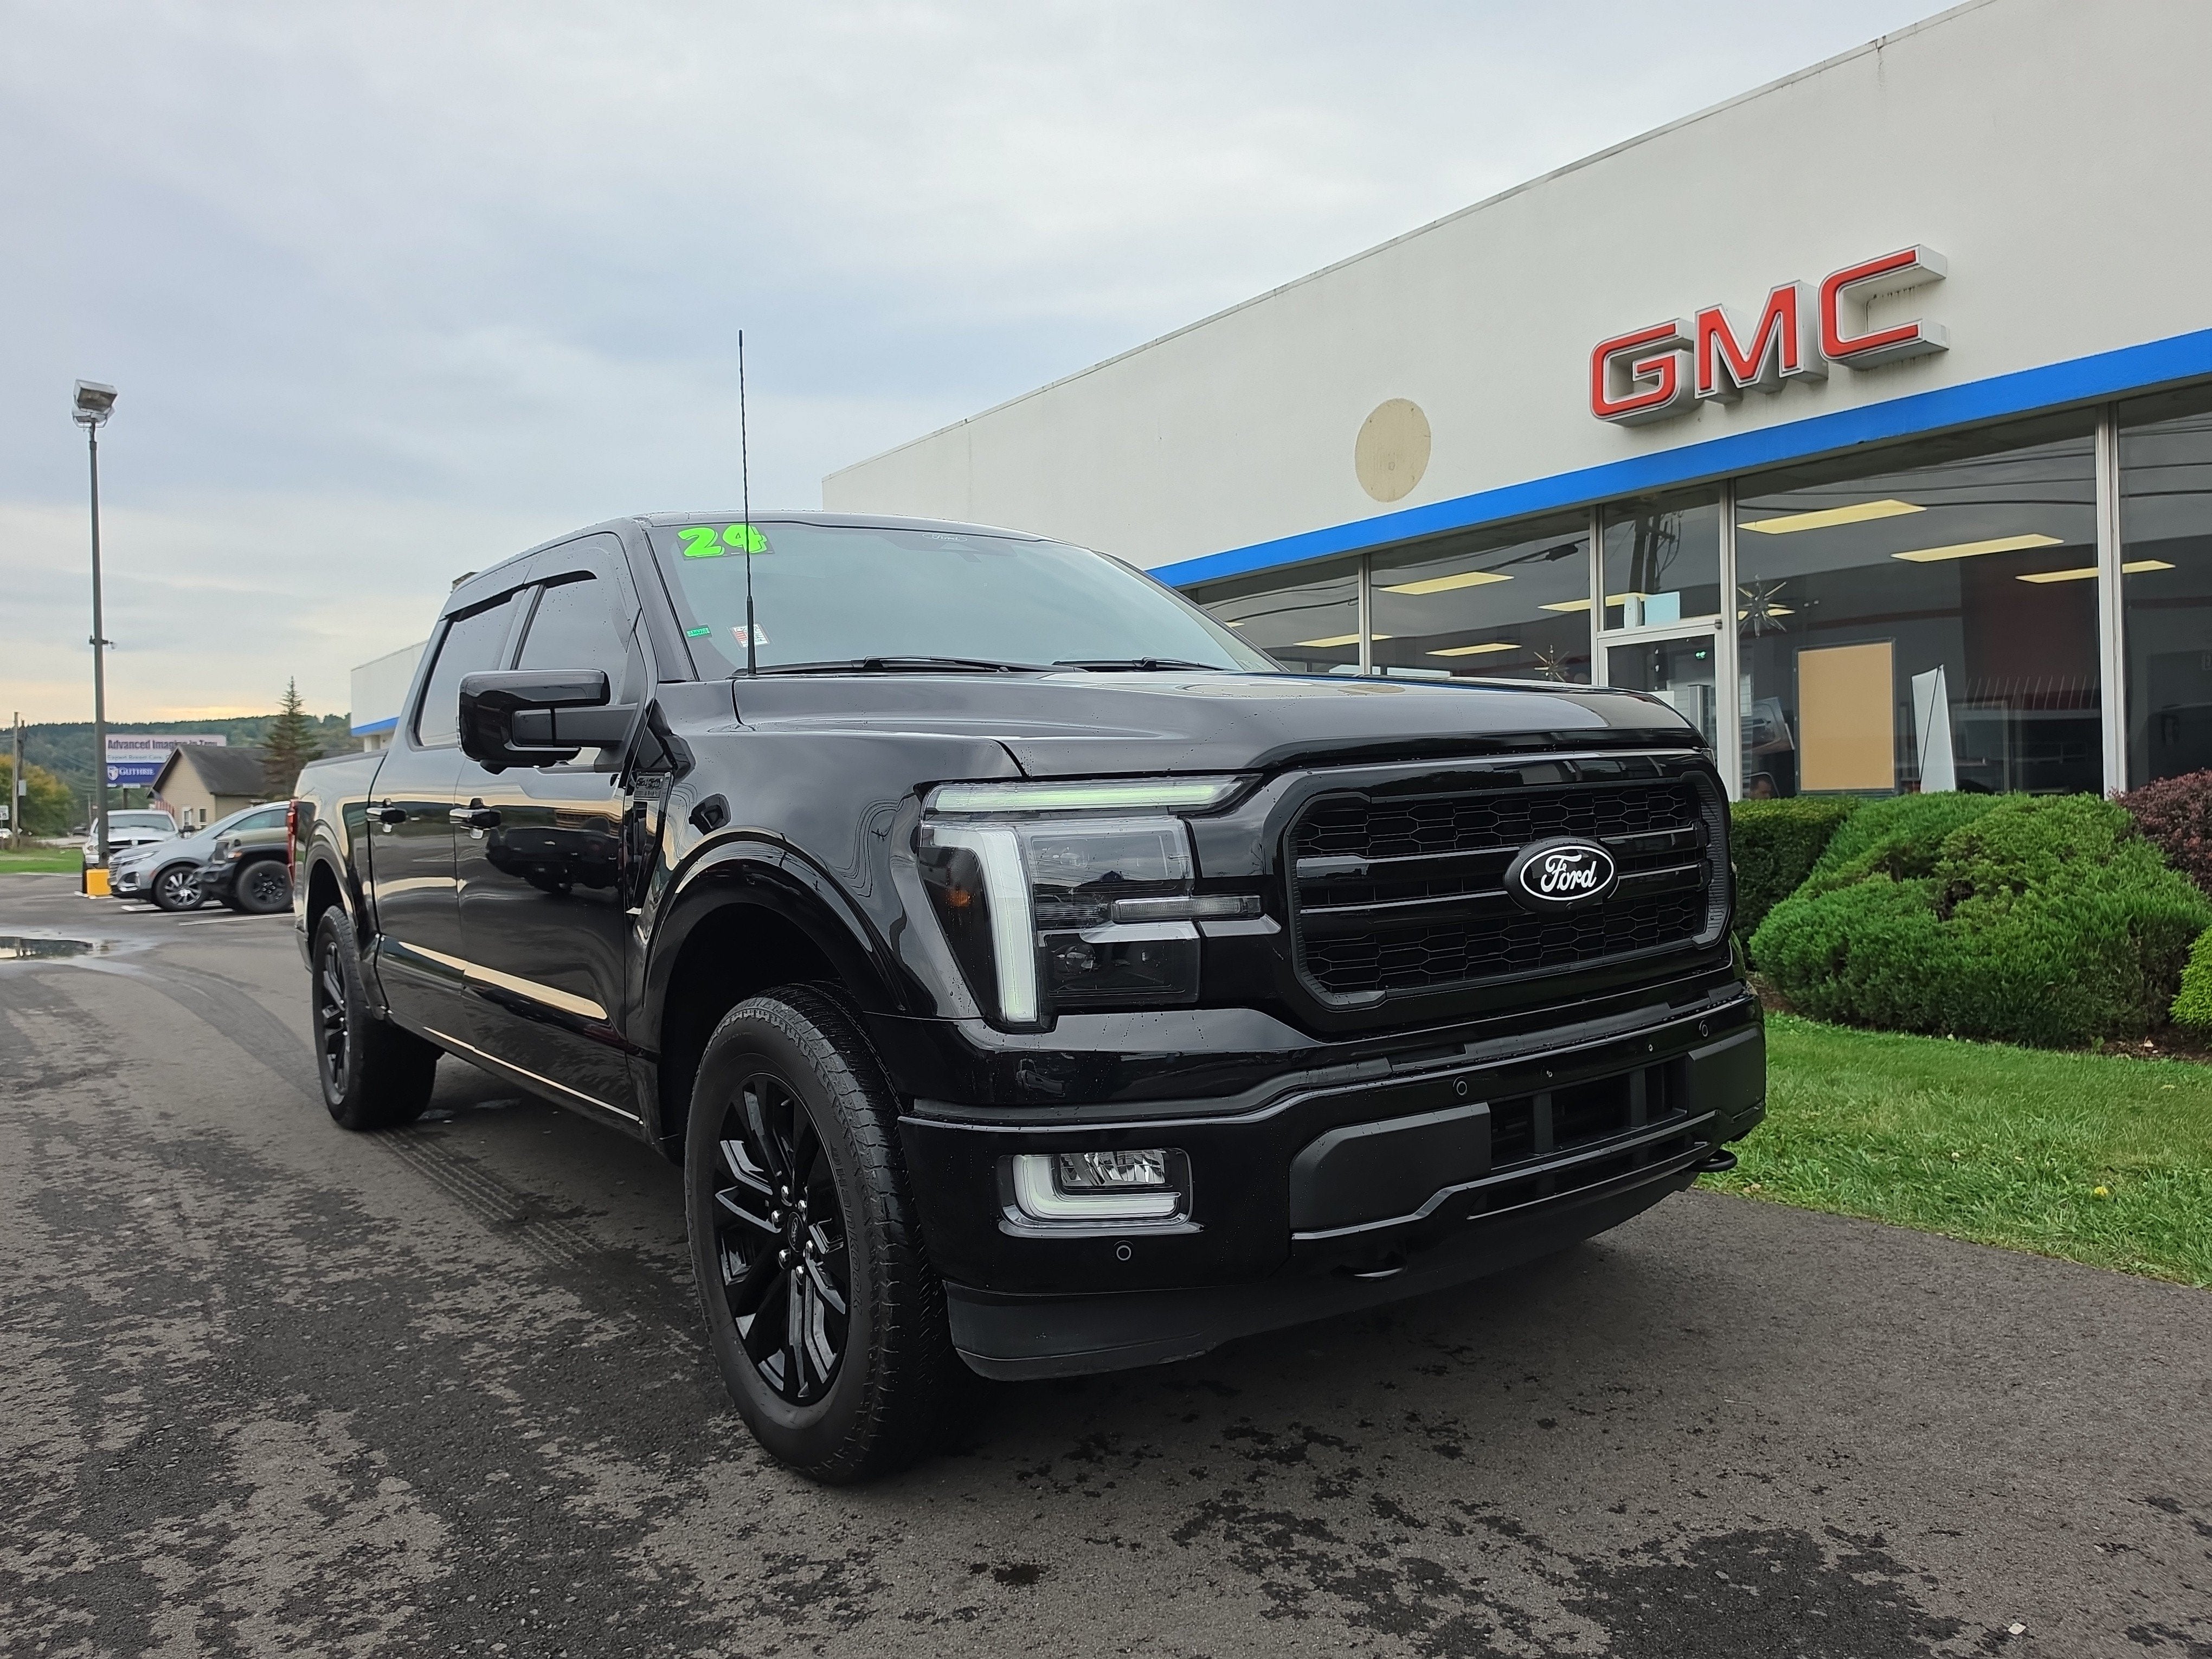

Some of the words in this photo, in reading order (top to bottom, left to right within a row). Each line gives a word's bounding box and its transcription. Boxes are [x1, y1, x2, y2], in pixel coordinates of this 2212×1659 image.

[1590, 244, 1930, 423] GMC
[678, 524, 767, 557] 24
[108, 740, 151, 749] Advanced
[119, 767, 155, 776] GUTHRIE
[1541, 853, 1597, 892] Ford
